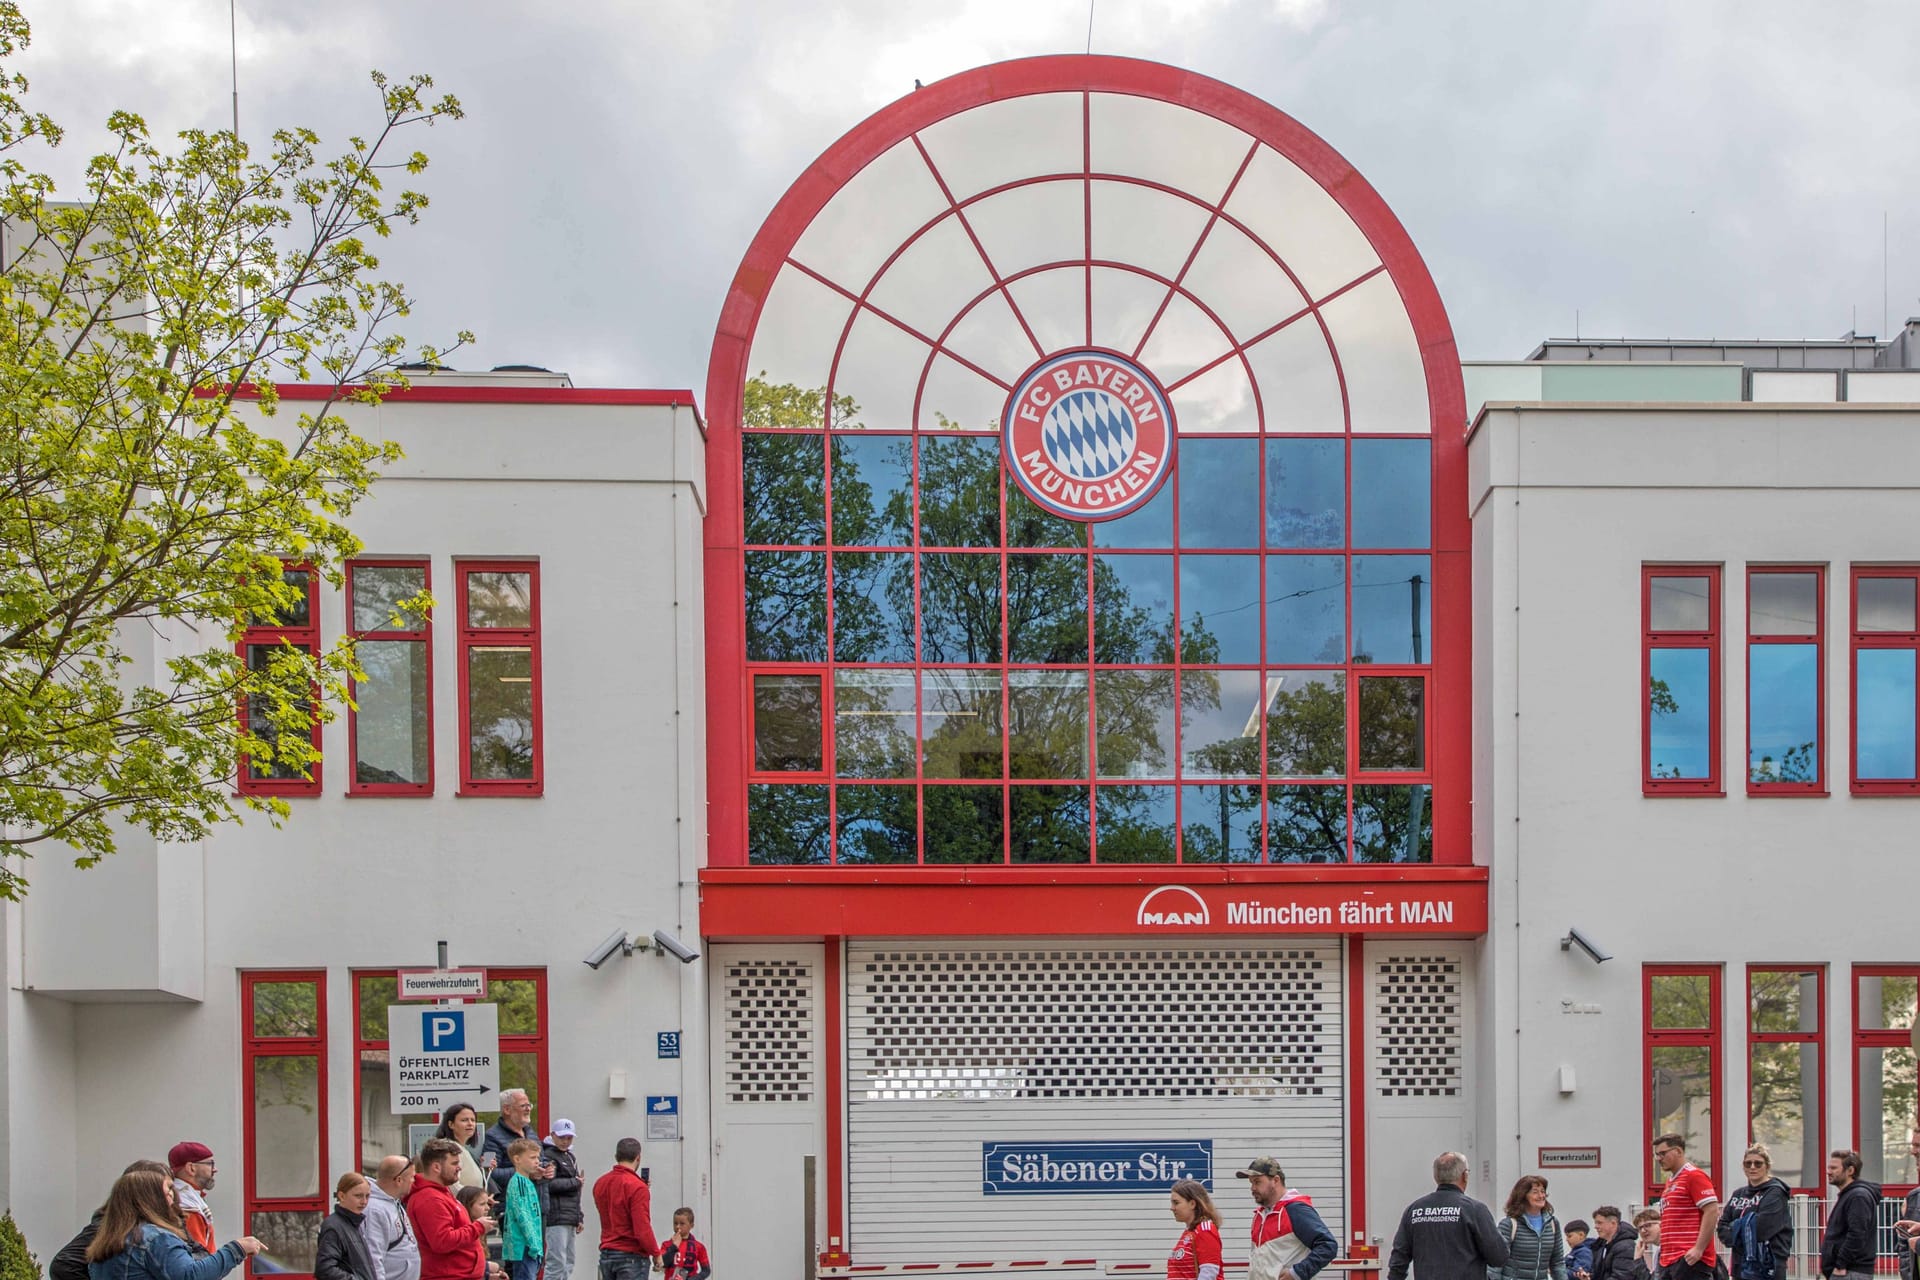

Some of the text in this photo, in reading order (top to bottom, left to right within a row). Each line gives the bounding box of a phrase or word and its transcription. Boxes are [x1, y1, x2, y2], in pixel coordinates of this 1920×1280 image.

[1020, 364, 1158, 424] FC BAYERN
[1022, 449, 1157, 506] MÜNCHEN
[1143, 912, 1204, 925] MAN
[1227, 900, 1454, 925] München fährt MAN
[406, 978, 480, 989] Feuerwehrzufahrt
[432, 1017, 456, 1047] P
[660, 1034, 677, 1046] 53
[399, 1056, 490, 1068] ÖFFENTLICHER
[400, 1070, 469, 1081] PARKPLATZ
[400, 1096, 439, 1106] 200 m
[1543, 1153, 1597, 1161] Feuerwehrzufahrt
[1002, 1152, 1194, 1183] Säbener Str.
[1412, 1206, 1461, 1218] FC BAYERN
